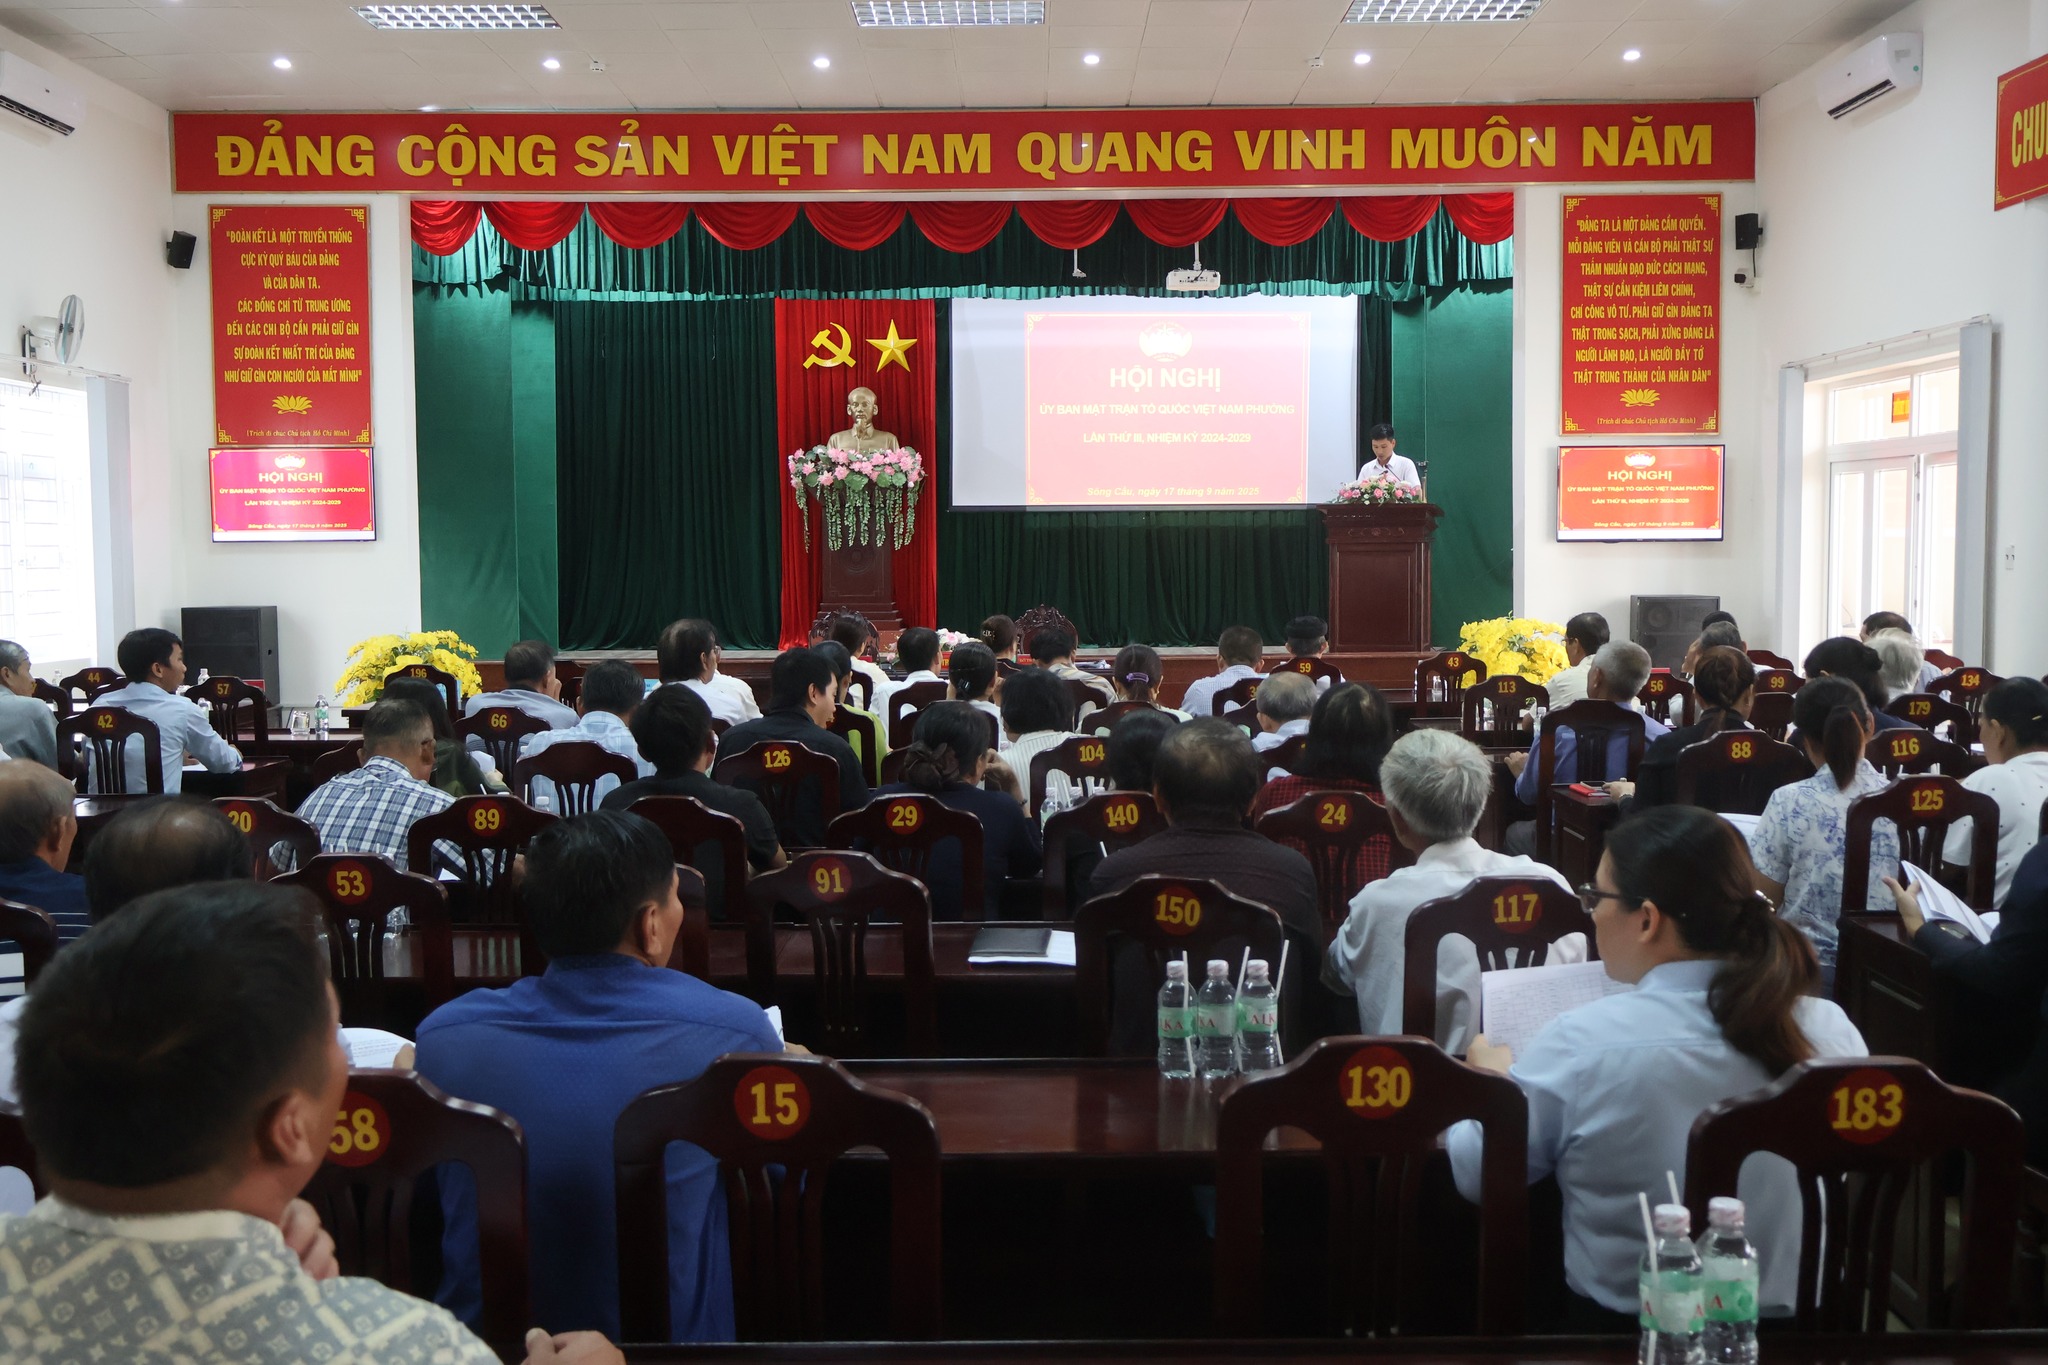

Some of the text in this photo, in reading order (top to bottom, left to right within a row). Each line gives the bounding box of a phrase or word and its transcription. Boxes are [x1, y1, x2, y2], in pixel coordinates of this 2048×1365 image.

[2011, 101, 2048, 168] CHU
[215, 115, 1712, 186] ĐẢNG CỘNG SẢN VIỆT NAM QUANG VINH MUÔN NĂM
[1601, 220, 1610, 232] TA
[1612, 216, 1621, 232] LÀ
[1623, 216, 1638, 234] MỘT
[1640, 214, 1659, 231] ĐẢNG
[253, 227, 266, 243] KẾT
[268, 228, 276, 243] LÀ
[280, 228, 296, 246] MỘT
[299, 227, 327, 243] TRUYỀN
[328, 227, 352, 243] THỐNG
[1584, 236, 1713, 255] ĐẢNG VIÊN VÀ CÁN BỘ PHẢI THẬT SỰ
[258, 251, 267, 266] KỲ
[269, 251, 283, 268] QUÝ
[286, 251, 300, 266] BÁU
[302, 249, 317, 266] CỦA
[319, 249, 339, 266] ĐẢNG
[1630, 259, 1707, 277] ĐẠO CÁCH MẠNG,
[263, 273, 320, 289] VÀ CỦA DÂN TA.
[1583, 281, 1695, 299] THẬT SỰ LIÊM CHÍNH,
[238, 298, 252, 312] CÁC
[255, 296, 275, 312] ĐỒNG
[278, 298, 290, 312] CHÍ
[305, 300, 329, 312] TRUNG
[1571, 304, 1583, 318] CHÍ
[1585, 304, 1604, 318] CÔNG
[1607, 304, 1617, 318] VÔ
[1633, 301, 1649, 318] PHẢI
[1666, 303, 1678, 318] GÌN
[1681, 301, 1700, 318] ĐẢNG
[1703, 305, 1712, 317] TA
[227, 320, 242, 335] ĐẾN
[246, 320, 261, 335] CÁC
[264, 323, 276, 335] CHI
[280, 320, 290, 338] BỘ
[293, 319, 308, 335] CẦN
[312, 318, 329, 335] PHẢI
[346, 320, 359, 335] GÌN
[1572, 323, 1714, 342] THẬT TRONG SẠCH, PHẢI ĐÁNG LÀ
[234, 343, 355, 362] SỰ ĐOÀN KẾT NHẤT TRÍ CỦA ĐẢNG
[1620, 346, 1648, 363] ĐẠO, LÀ
[224, 369, 239, 382] NHƯ
[267, 370, 282, 382] CON
[307, 366, 320, 382] CỦA
[1573, 369, 1592, 385] THẬT
[1595, 371, 1620, 383] TRUNG
[1623, 367, 1648, 382] THÀNH
[1651, 366, 1666, 382] CỦA
[1669, 367, 1689, 382] NHÂN
[259, 472, 322, 484] HỘI NGHỊ
[1608, 470, 1672, 482] HỘI NGHỊ
[1300, 663, 1311, 672] 59
[1448, 658, 1459, 666] 43
[88, 674, 100, 682] 44
[411, 668, 426, 678] 196
[1961, 675, 1979, 686] 134
[218, 684, 229, 694] 57
[1498, 681, 1516, 693] 113
[1651, 680, 1663, 691] 56
[1772, 677, 1784, 688] 99
[1909, 701, 1931, 715] 179
[98, 715, 113, 728] 42
[491, 714, 507, 728] 66
[1080, 744, 1105, 762] 104
[1732, 742, 1751, 758] 88
[1892, 738, 1919, 756] 116
[765, 750, 790, 767] 126
[1913, 790, 1943, 810] 125
[475, 809, 499, 829] 89
[892, 806, 917, 826] 29
[1106, 804, 1138, 827] 140
[1321, 803, 1346, 825] 24
[337, 871, 365, 896] 53
[816, 868, 843, 893] 91
[1156, 895, 1200, 926] 150
[1494, 894, 1538, 923] 117
[1347, 1066, 1411, 1107] 130
[752, 1083, 798, 1125] 15
[1833, 1085, 1902, 1130] 183
[330, 1109, 379, 1154] 58
